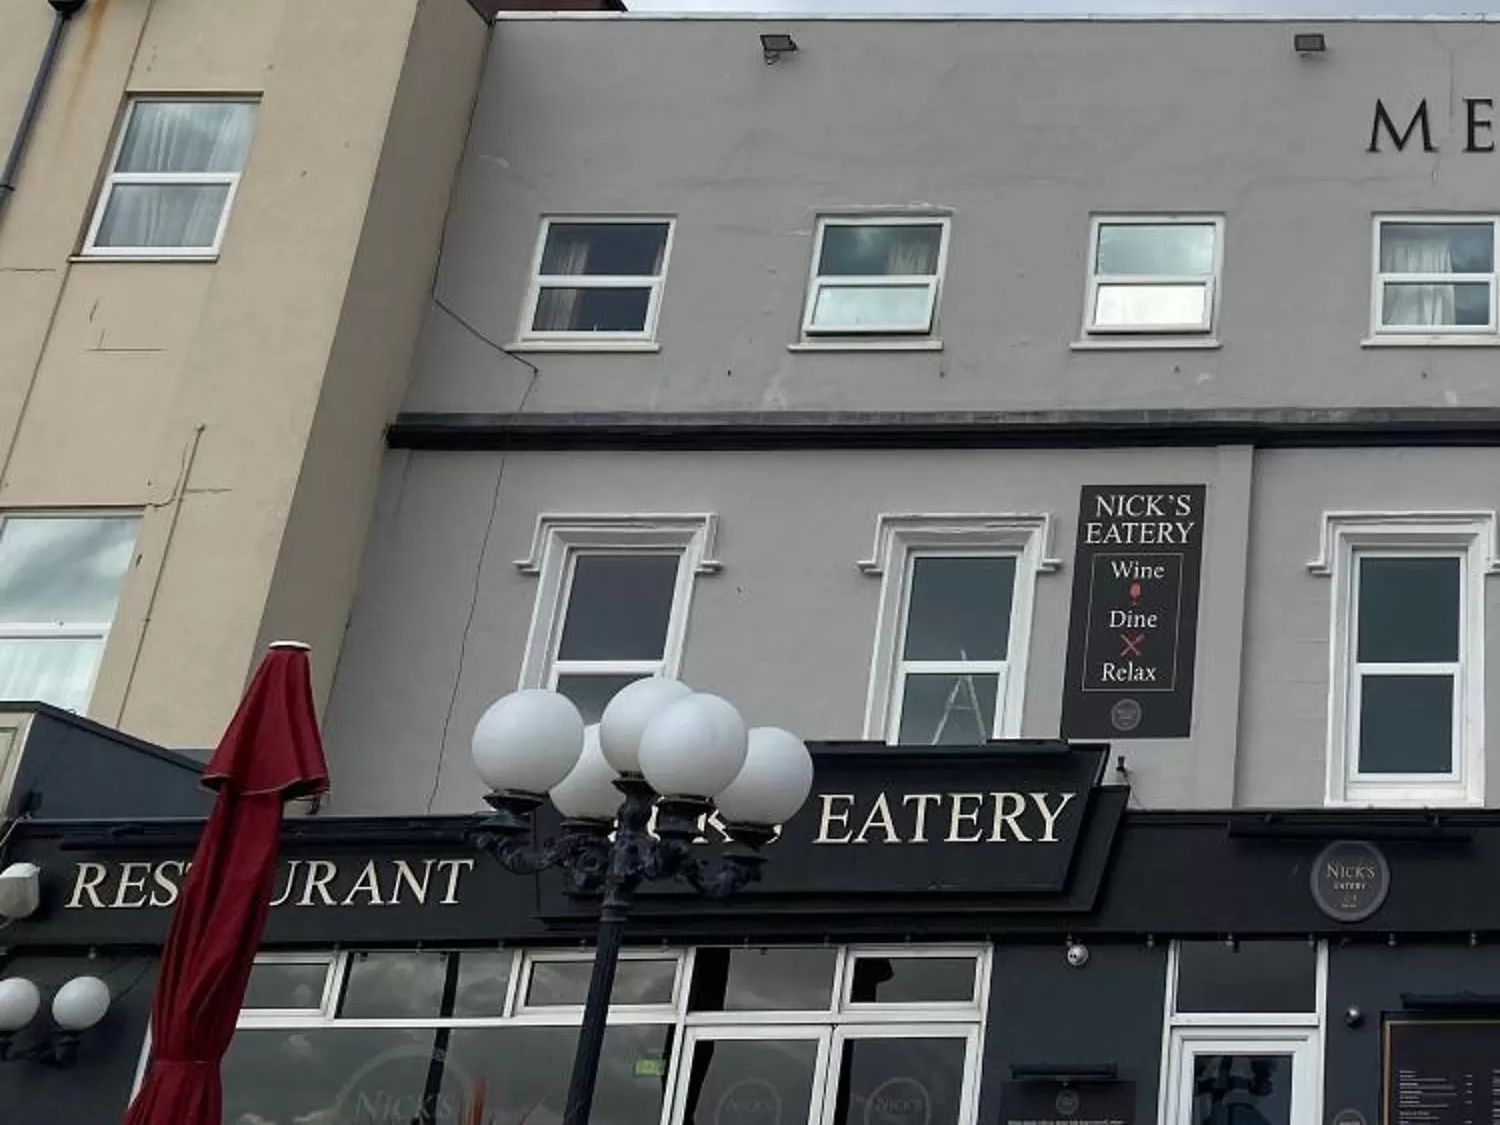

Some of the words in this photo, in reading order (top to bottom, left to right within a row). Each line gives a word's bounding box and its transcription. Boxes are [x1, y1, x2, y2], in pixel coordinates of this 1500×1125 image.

[1095, 494, 1192, 518] NICK'S
[1084, 522, 1196, 545] EATERY
[1111, 560, 1166, 580] Wine
[1109, 610, 1158, 629] Dine
[1100, 661, 1157, 682] Relax
[813, 792, 1076, 844] EATERY
